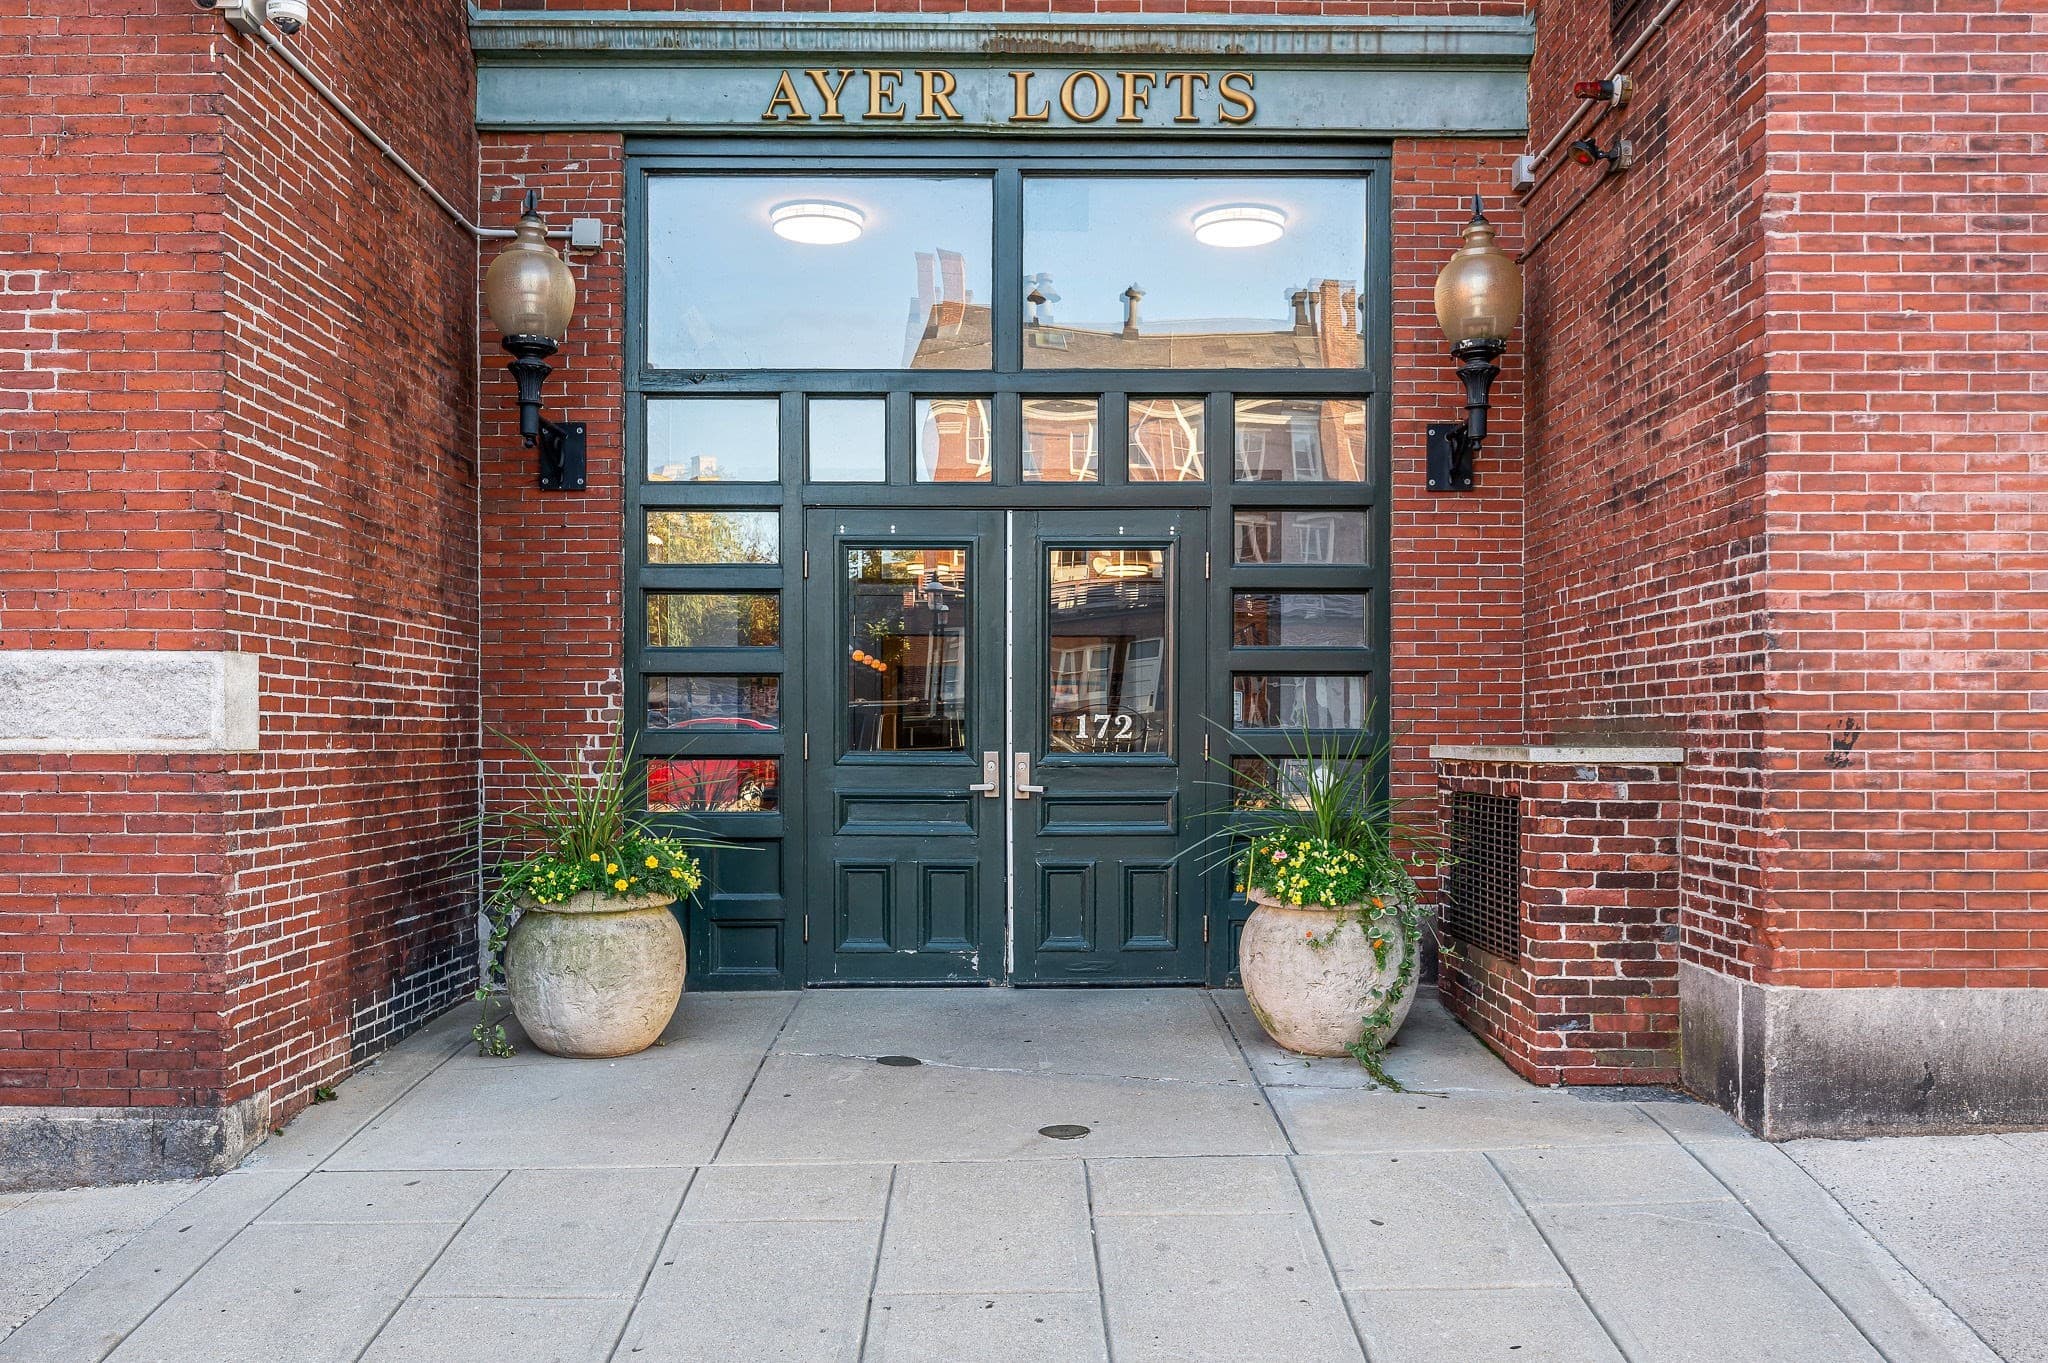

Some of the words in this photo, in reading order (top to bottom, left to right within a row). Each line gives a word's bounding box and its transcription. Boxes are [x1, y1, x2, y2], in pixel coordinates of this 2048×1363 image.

[761, 69, 964, 121] AYER
[1008, 70, 1257, 124] LOFTS
[1075, 713, 1133, 739] 172
